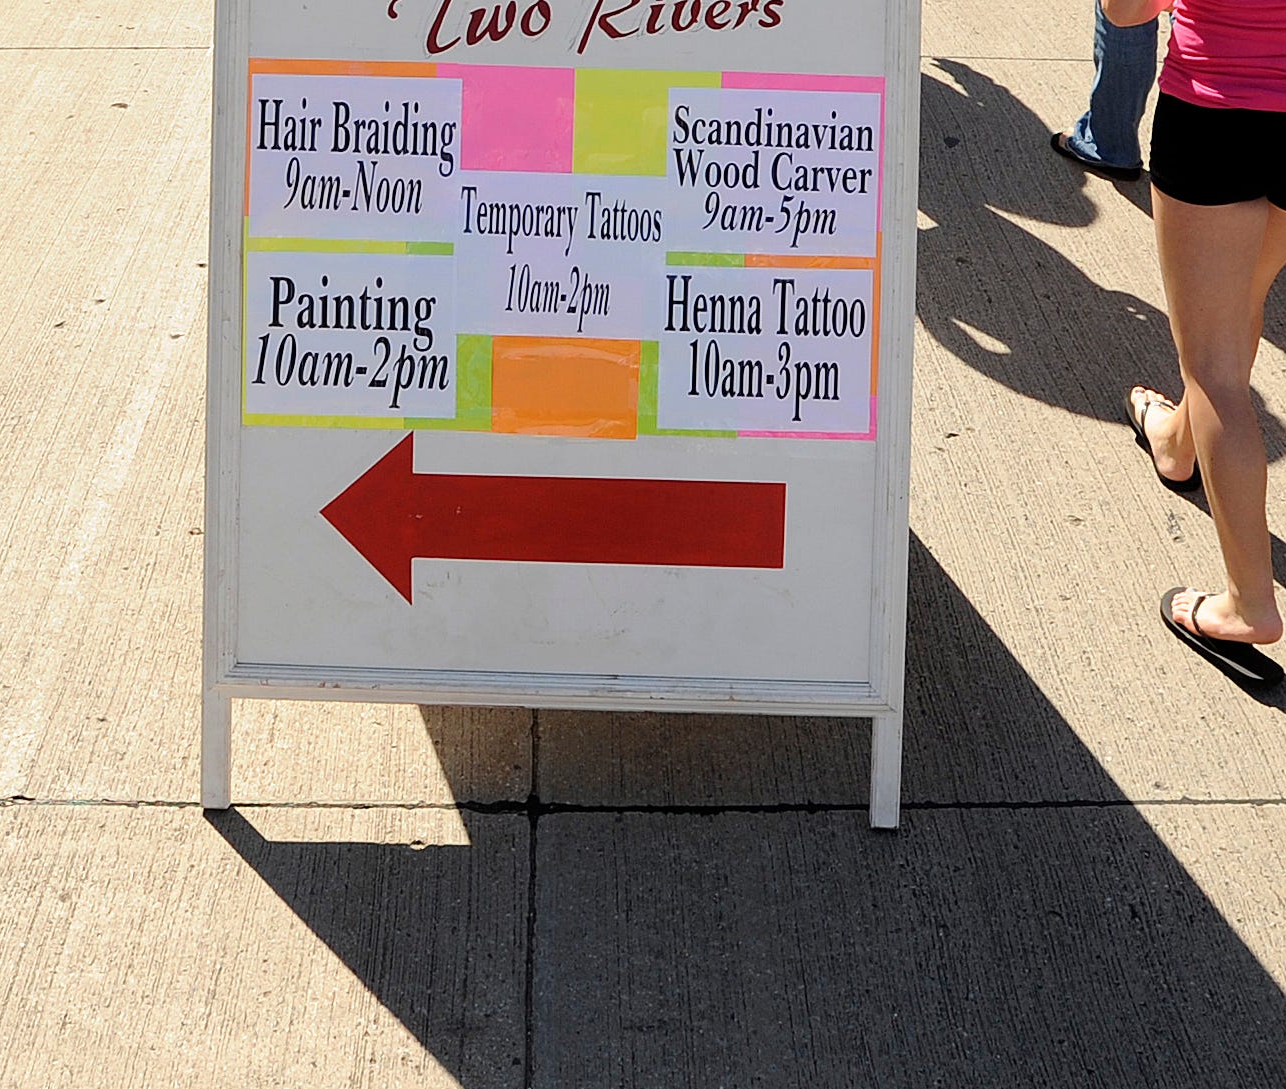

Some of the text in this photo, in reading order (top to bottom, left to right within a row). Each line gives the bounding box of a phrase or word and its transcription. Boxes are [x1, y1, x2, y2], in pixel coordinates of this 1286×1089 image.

[256, 97, 457, 177] Hair Braiding
[672, 105, 874, 152] Scandinavian
[283, 156, 423, 214] 9am-Noon
[673, 148, 873, 194] Wood Carver
[460, 185, 663, 256] Temporary Tattoos
[702, 191, 837, 248] 9am-5pm
[268, 275, 437, 352] Painting
[505, 263, 611, 333] 10am-2pm
[664, 274, 866, 338] Henna Tattoo
[251, 332, 450, 409] 10am-2pm
[687, 339, 840, 422] 10am-3pm
